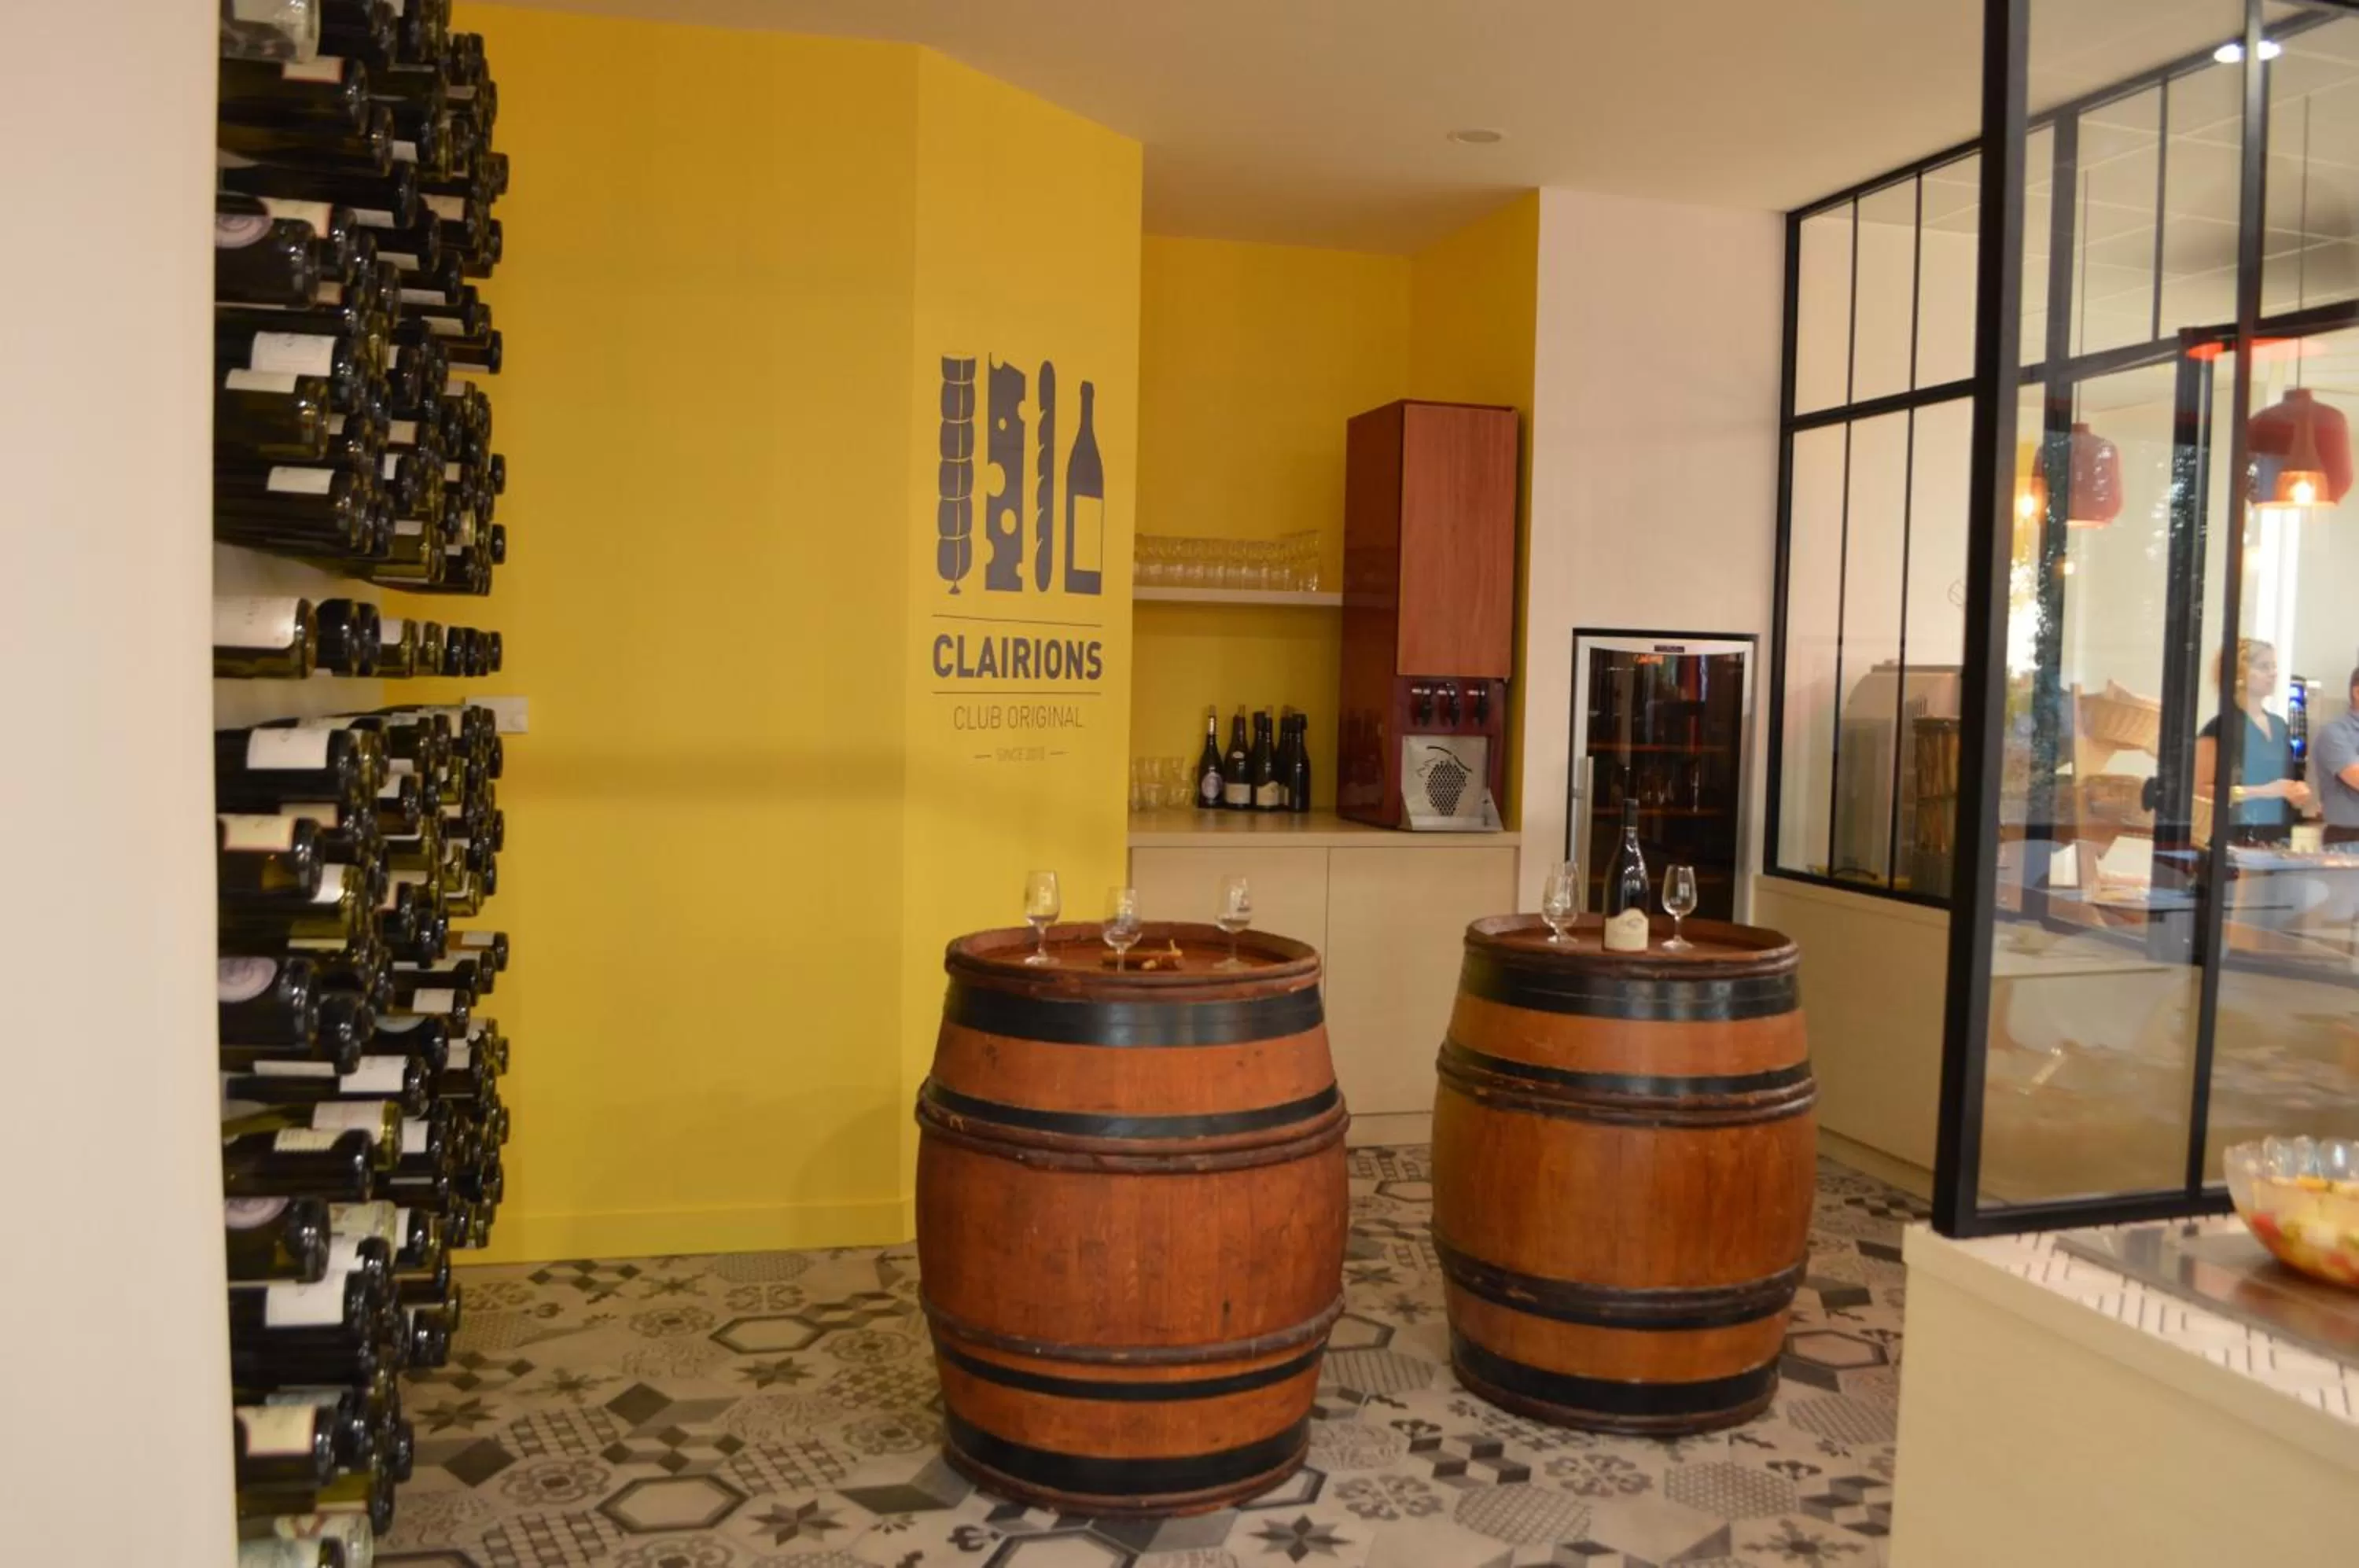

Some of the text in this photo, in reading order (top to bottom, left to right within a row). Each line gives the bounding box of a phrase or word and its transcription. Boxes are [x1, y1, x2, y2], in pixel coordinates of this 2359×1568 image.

[933, 634, 1102, 679] CLAIRIONS
[954, 705, 1084, 730] CLUB ORIGINAL
